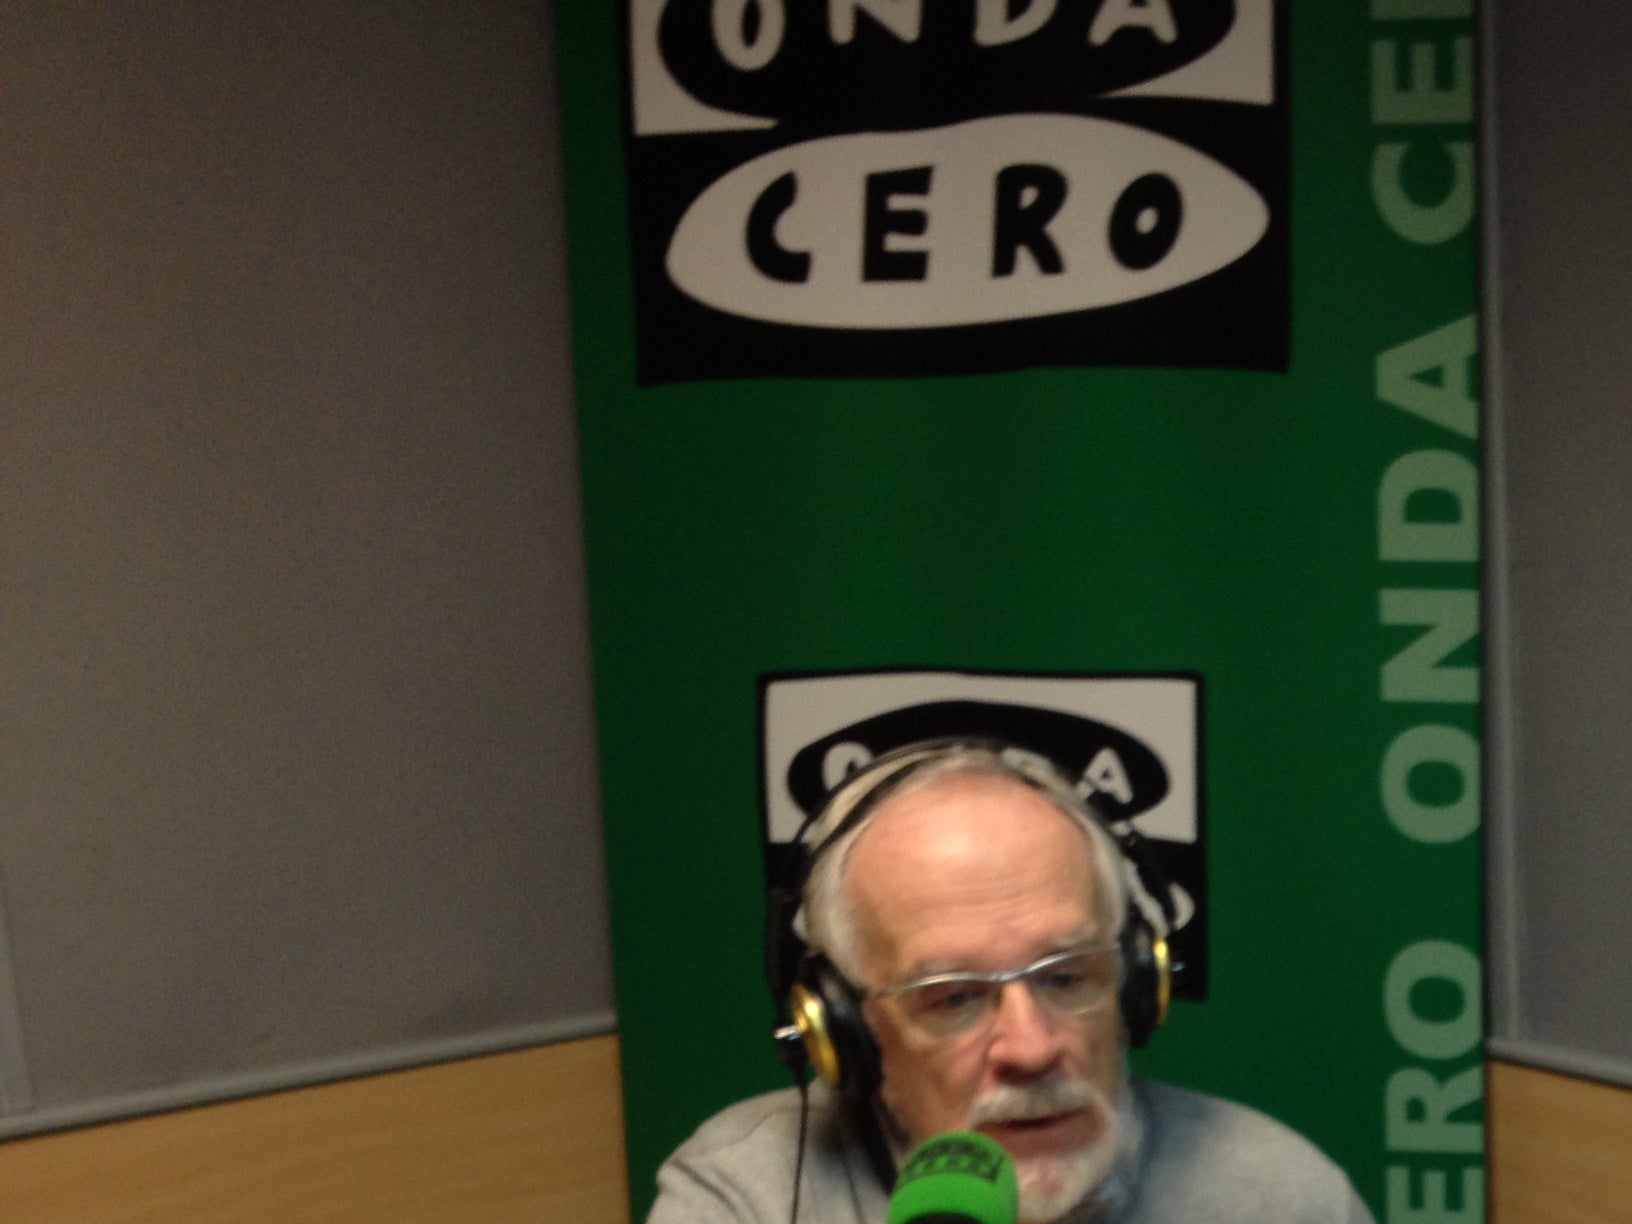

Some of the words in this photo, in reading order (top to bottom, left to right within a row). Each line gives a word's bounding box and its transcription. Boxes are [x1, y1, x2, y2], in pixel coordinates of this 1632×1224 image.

[744, 164, 1184, 284] CERO
[1370, 0, 1476, 245] CE
[1376, 311, 1483, 843] ONDA
